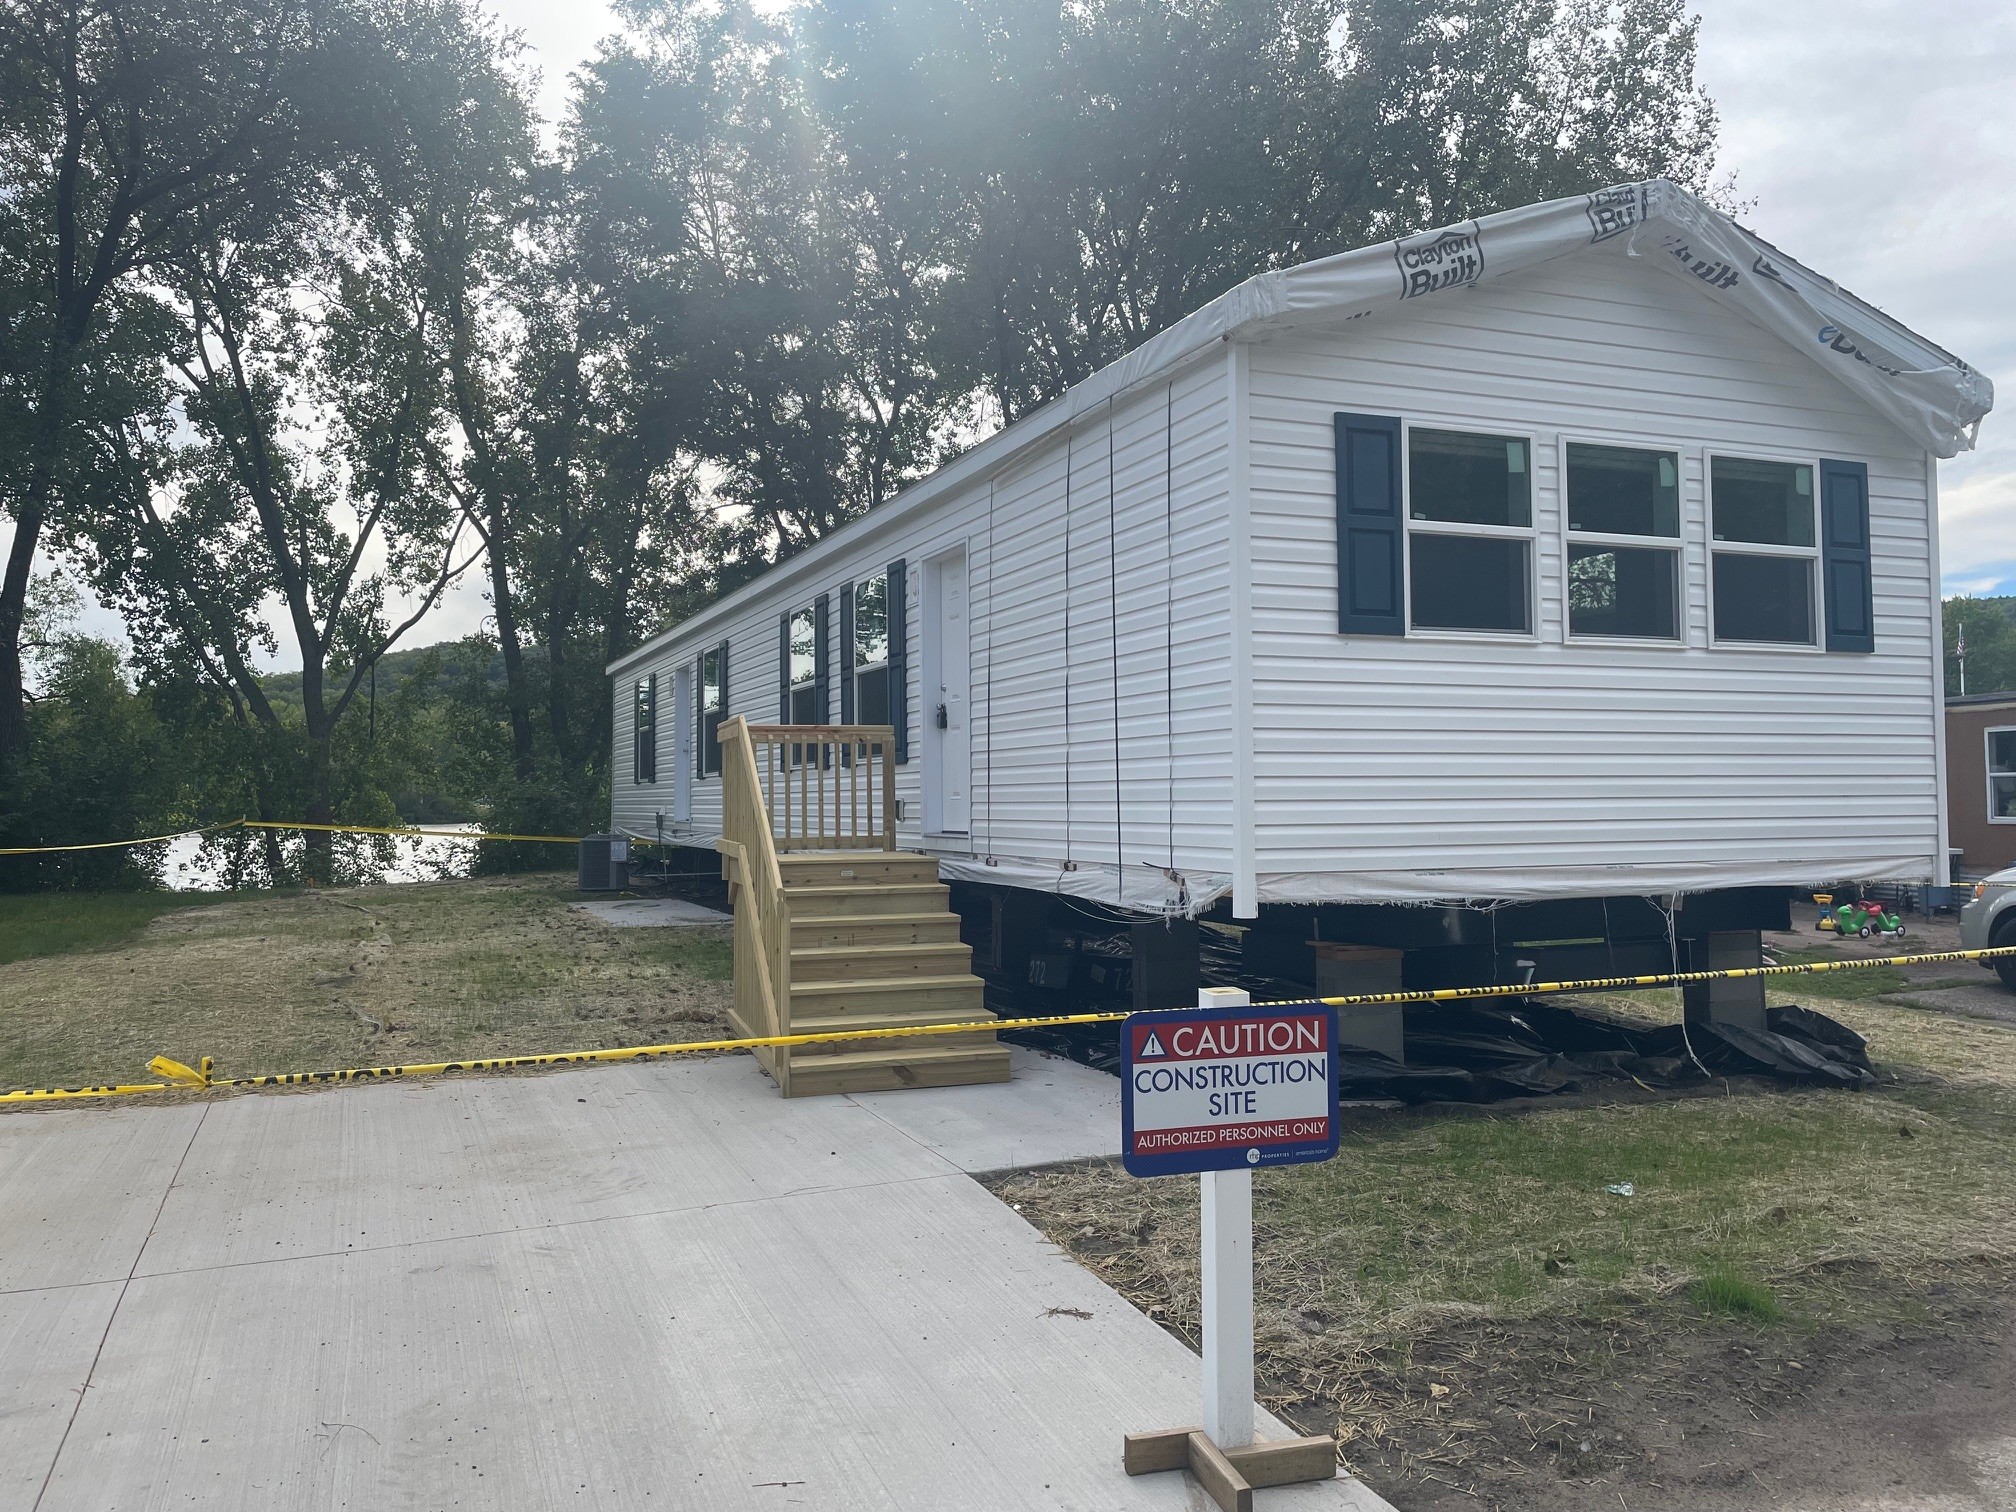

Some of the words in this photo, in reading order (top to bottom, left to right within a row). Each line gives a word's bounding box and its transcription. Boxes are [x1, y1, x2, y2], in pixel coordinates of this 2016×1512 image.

[1402, 236, 1472, 269] Clayton
[1406, 254, 1477, 299] Built
[1028, 960, 1046, 985] 272
[1172, 1020, 1320, 1057] CAUTION
[1134, 1058, 1326, 1094] CONSTRUCTION
[1208, 1090, 1257, 1117] SITE
[1138, 1130, 1216, 1149] AUTHORIZED
[1219, 1124, 1291, 1142] PERSONNEL
[1293, 1121, 1326, 1136] ONLY
[1261, 1152, 1290, 1160] PROPERTIES
